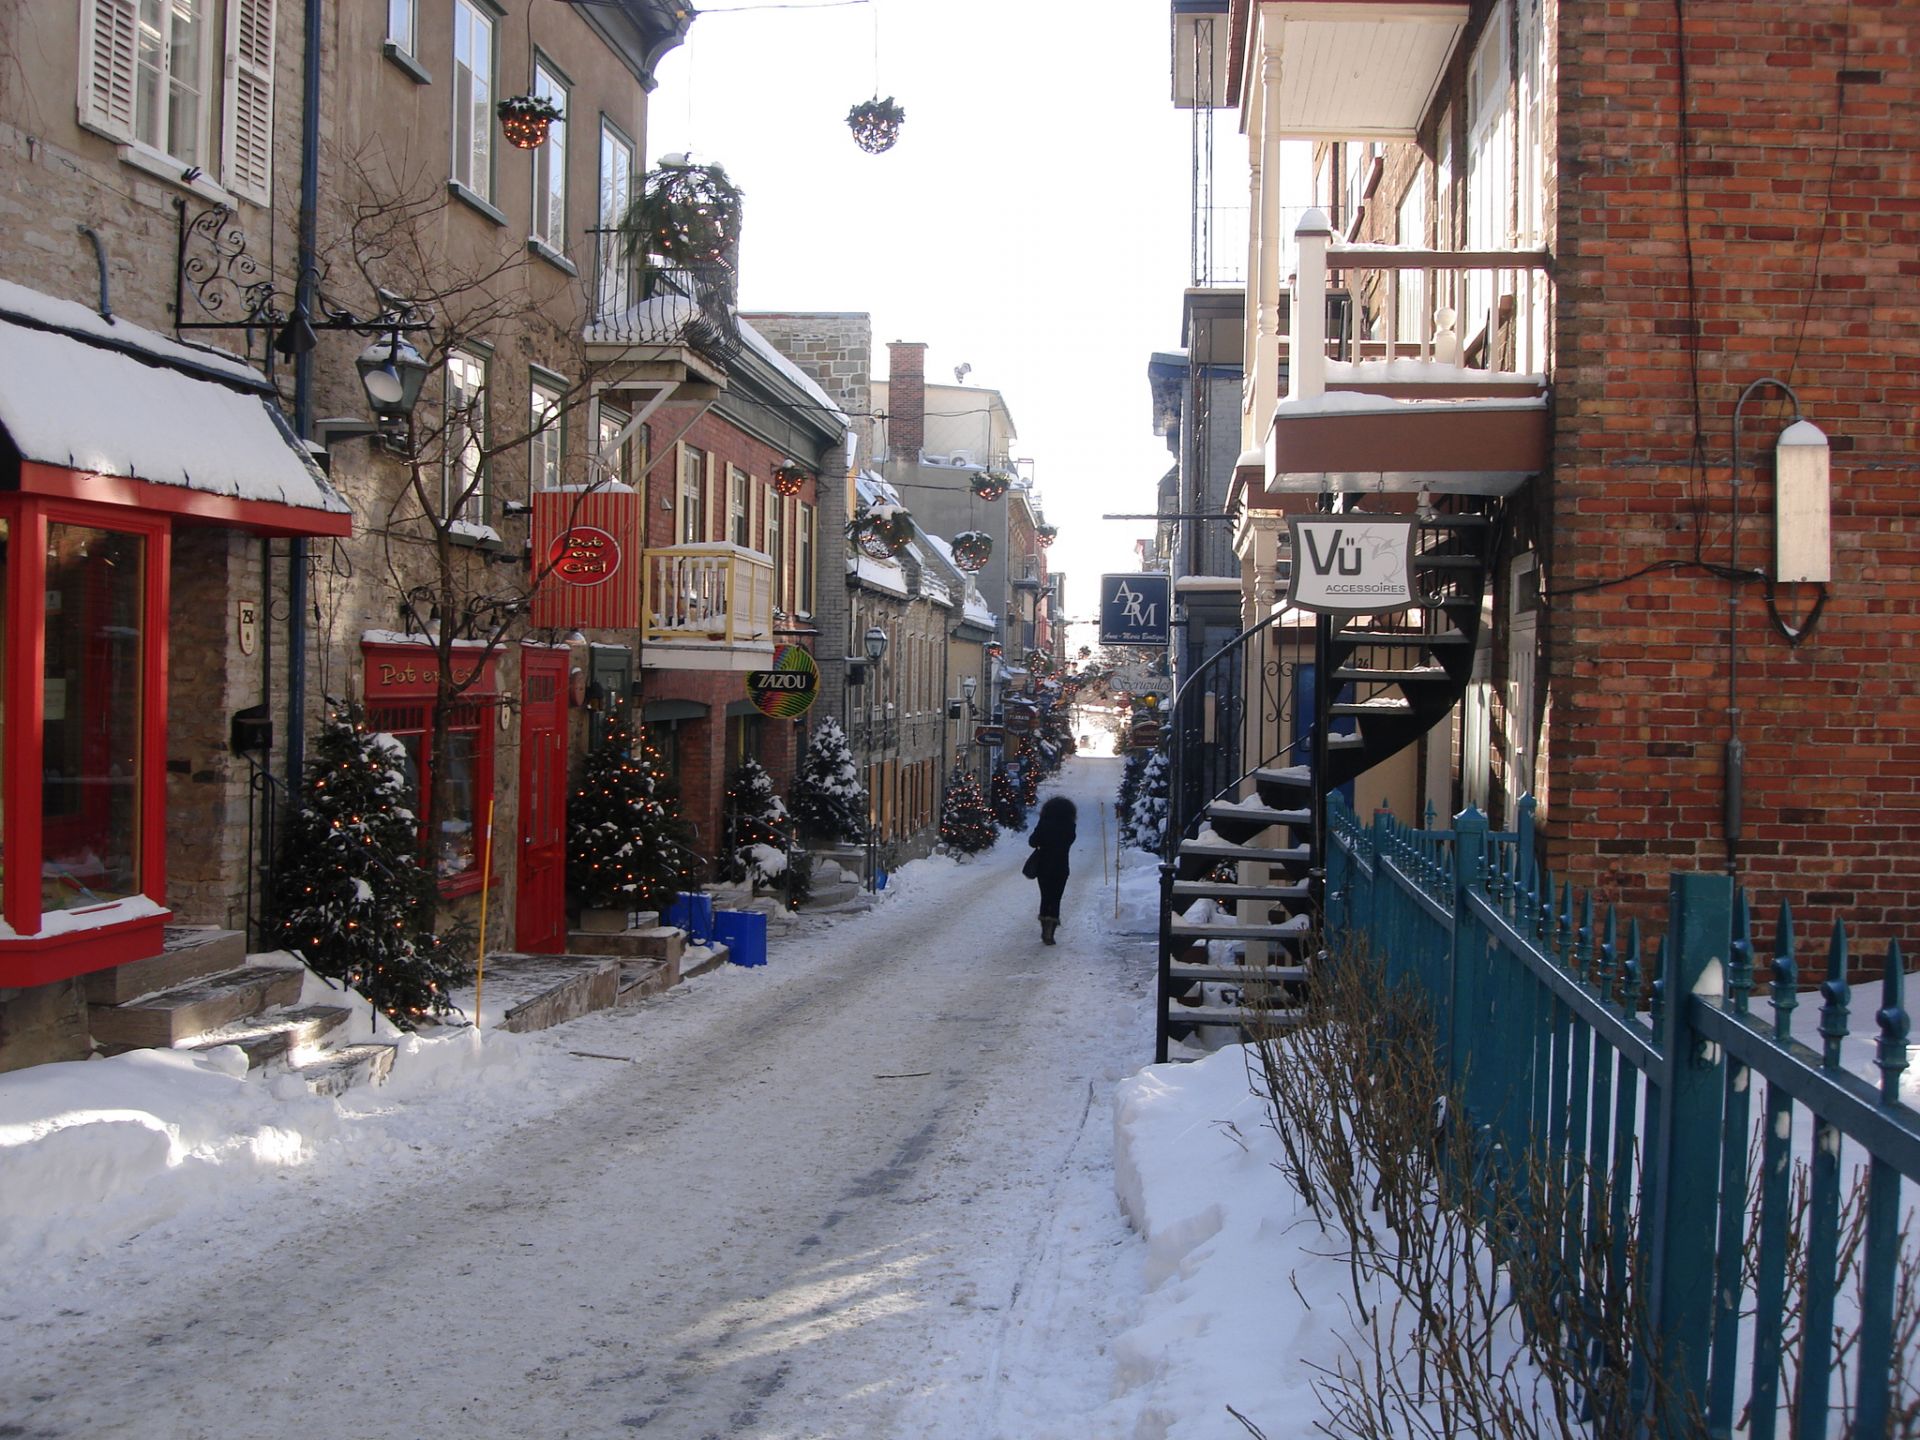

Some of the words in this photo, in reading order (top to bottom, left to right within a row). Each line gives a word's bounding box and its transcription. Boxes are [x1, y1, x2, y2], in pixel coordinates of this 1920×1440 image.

[568, 536, 604, 547] Pot
[563, 560, 606, 573] Ciel
[379, 662, 417, 685] Pot
[758, 674, 806, 689] ZAZOU
